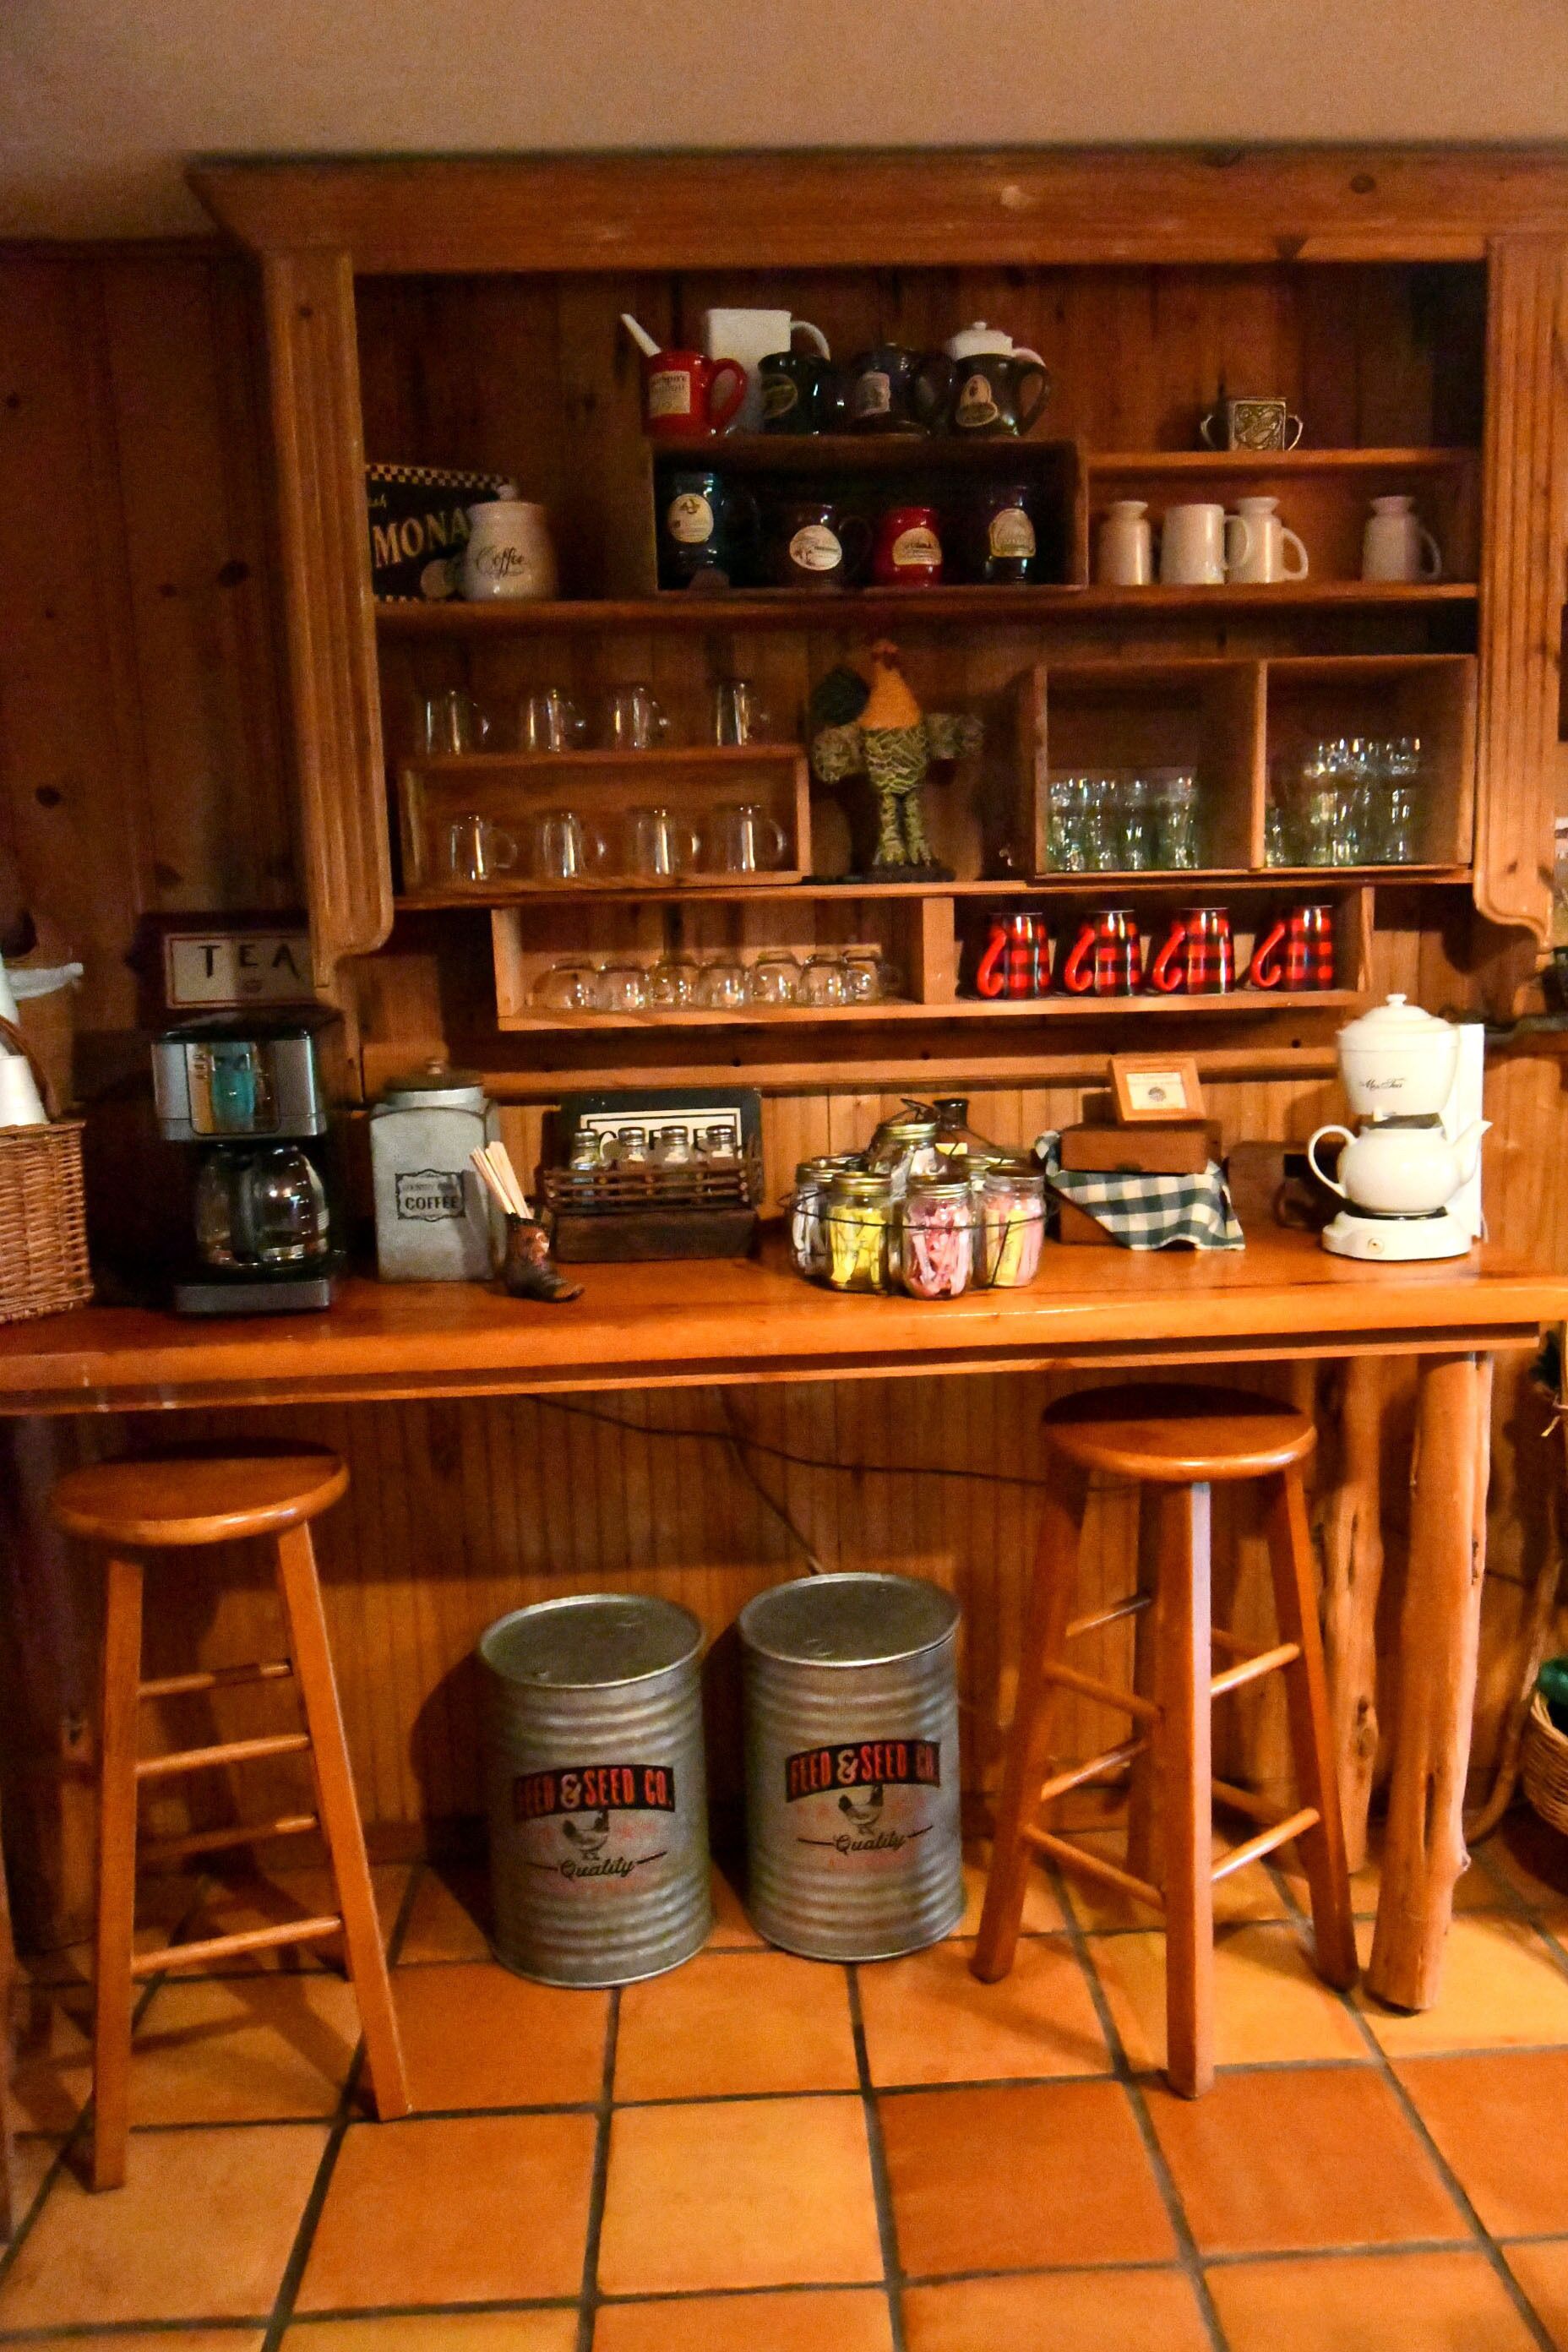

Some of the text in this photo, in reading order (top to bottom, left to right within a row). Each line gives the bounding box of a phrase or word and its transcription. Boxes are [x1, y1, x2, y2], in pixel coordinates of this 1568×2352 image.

[476, 546, 529, 578] Coffee
[198, 943, 302, 979] TEA
[405, 1196, 460, 1211] COFFEE
[790, 1750, 832, 1799] FEED
[836, 1749, 859, 1786] &
[859, 1743, 908, 1783] SEED
[559, 1772, 583, 1810] &
[583, 1767, 636, 1806] SEED
[832, 1829, 907, 1856] Quality
[558, 1855, 636, 1883] Quality
